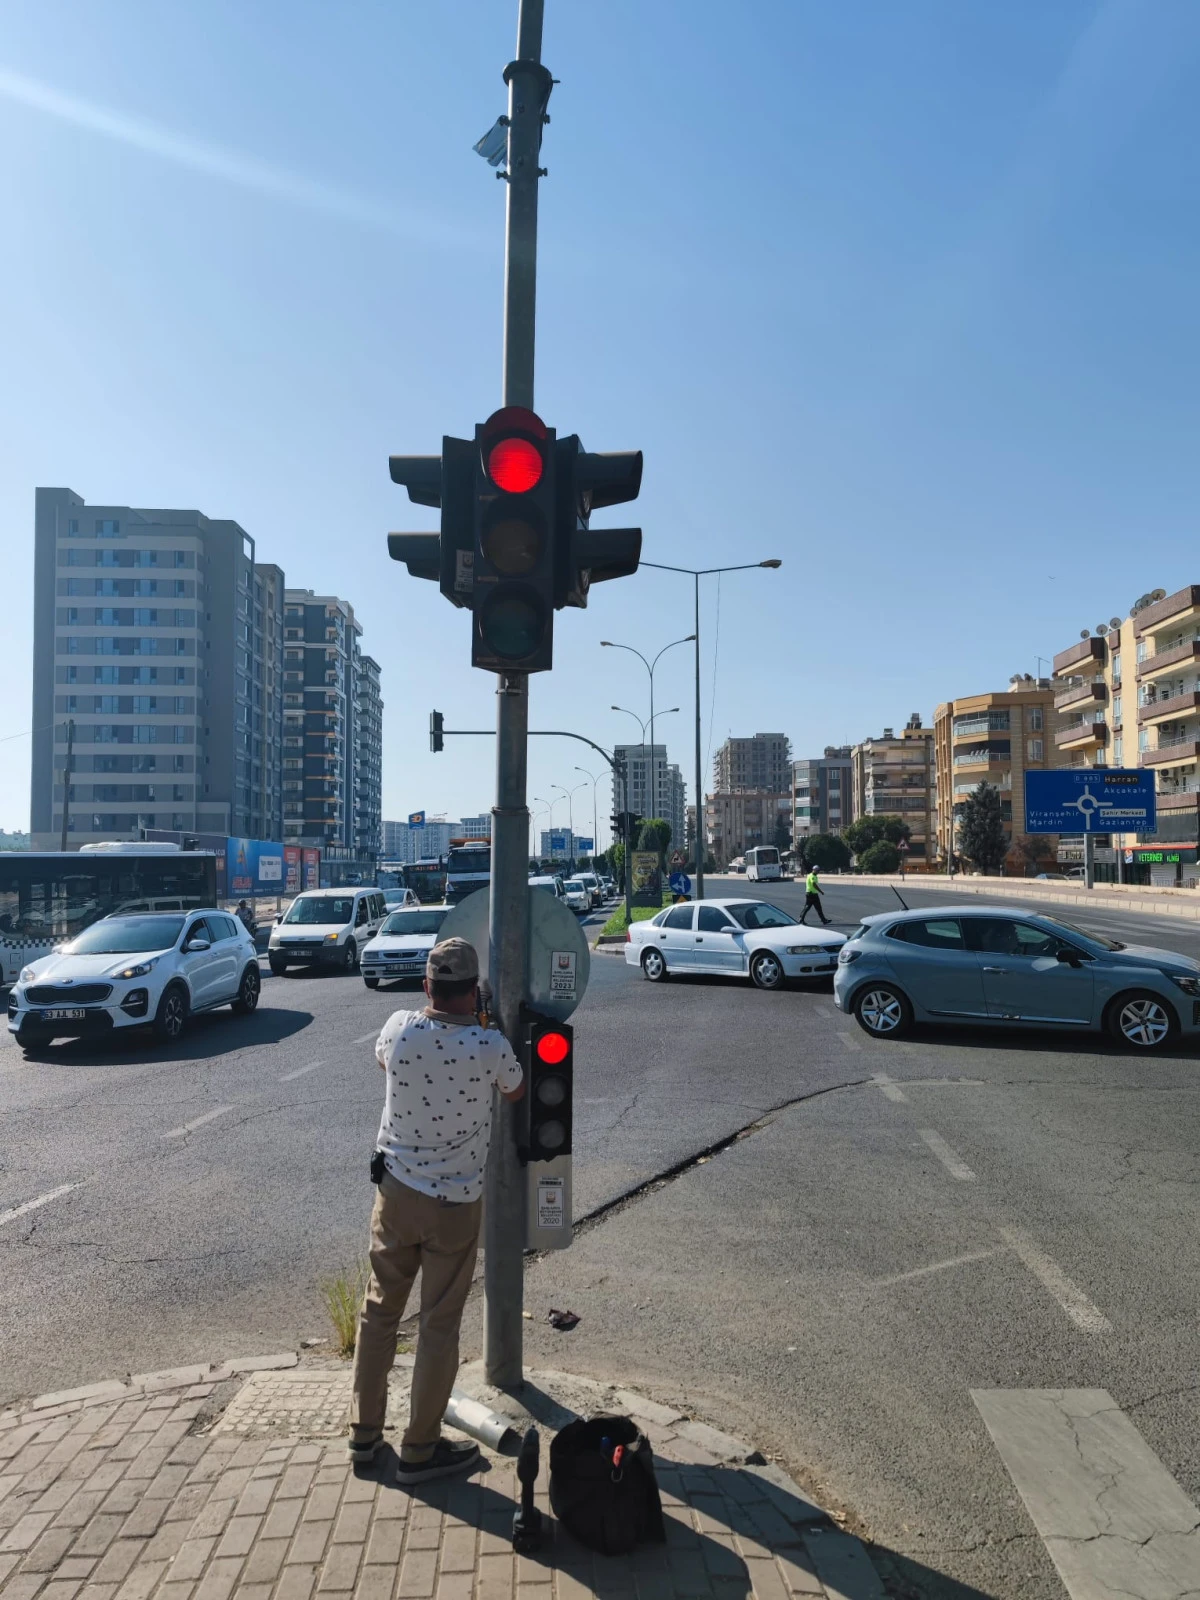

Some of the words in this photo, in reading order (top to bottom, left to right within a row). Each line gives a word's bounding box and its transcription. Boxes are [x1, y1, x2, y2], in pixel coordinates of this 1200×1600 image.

[1030, 810, 1080, 818] Viranşehir
[1100, 819, 1147, 827] Gaziantep
[57, 1010, 69, 1018] AJL
